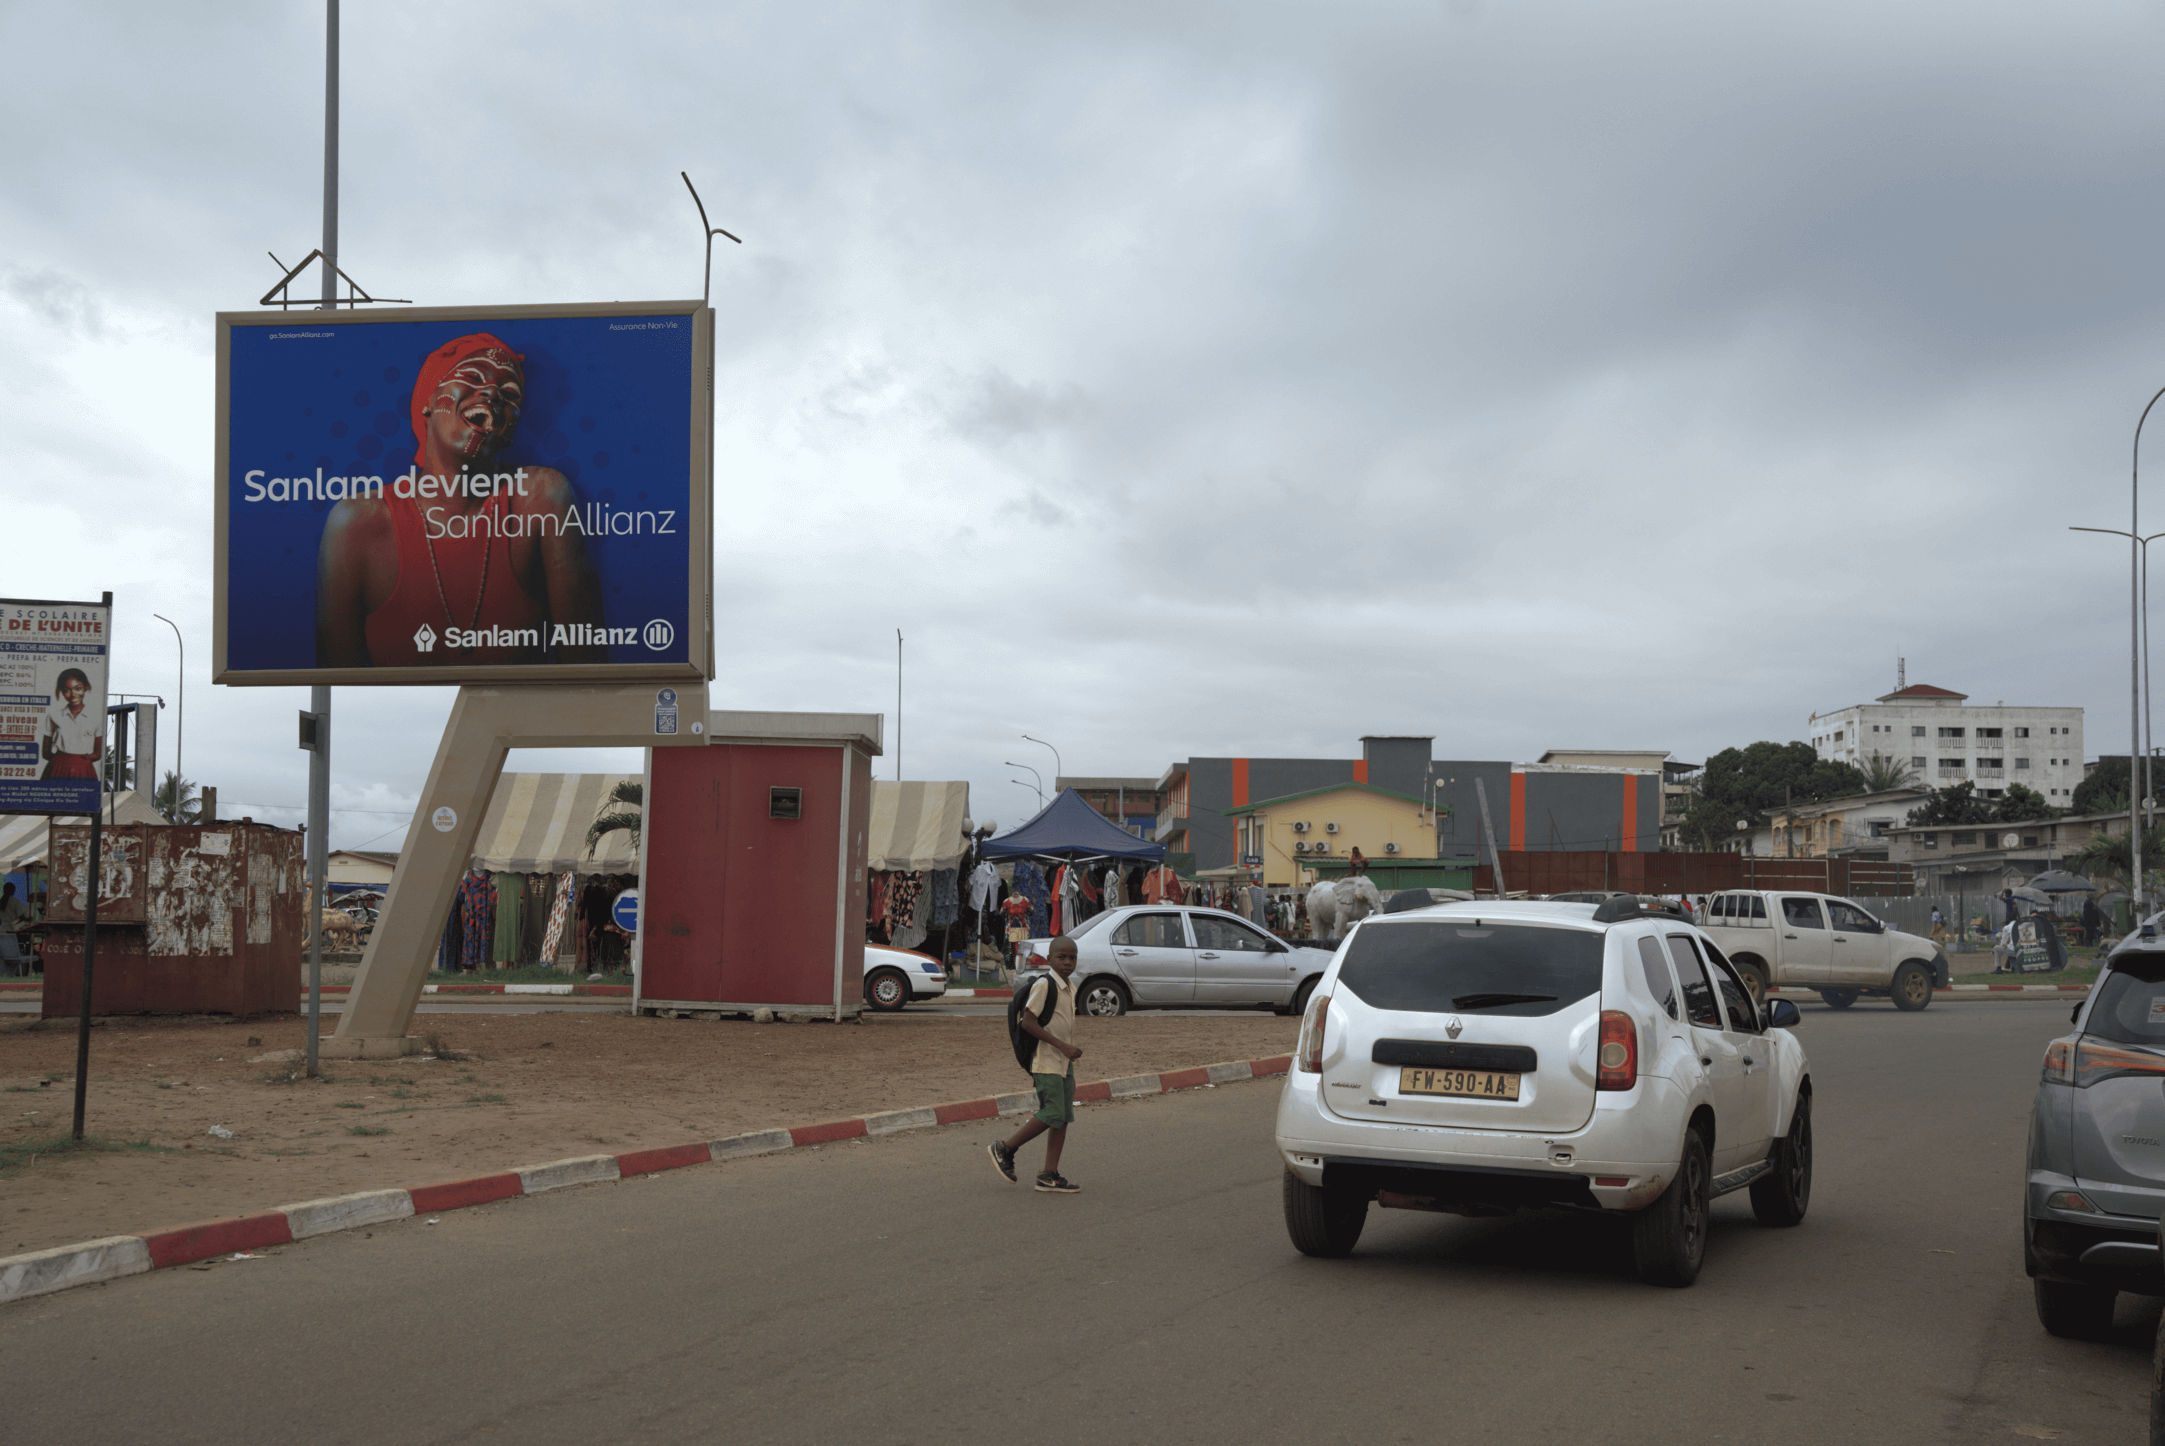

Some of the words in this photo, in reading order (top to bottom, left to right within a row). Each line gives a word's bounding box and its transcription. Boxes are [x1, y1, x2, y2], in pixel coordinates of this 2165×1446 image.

[609, 323, 647, 331] Assurance
[648, 321, 678, 329] Non-Vie
[245, 468, 383, 501] Sanlam
[394, 465, 528, 498] devient
[426, 503, 675, 538] SanlamAllianz
[17, 610, 97, 620] SCOLAIRE
[9, 619, 31, 631] DE
[38, 620, 102, 633] L'UNITE
[445, 625, 537, 647] Sanlam
[551, 624, 637, 645] Allianz
[82, 656, 99, 664] BEPC
[6, 715, 38, 724] niveau
[4, 767, 14, 777] 32
[15, 767, 25, 777] 22
[26, 768, 36, 777] 48
[1412, 1070, 1505, 1095] FW-590-AA
[2121, 1134, 2161, 1147] TOYOTA
